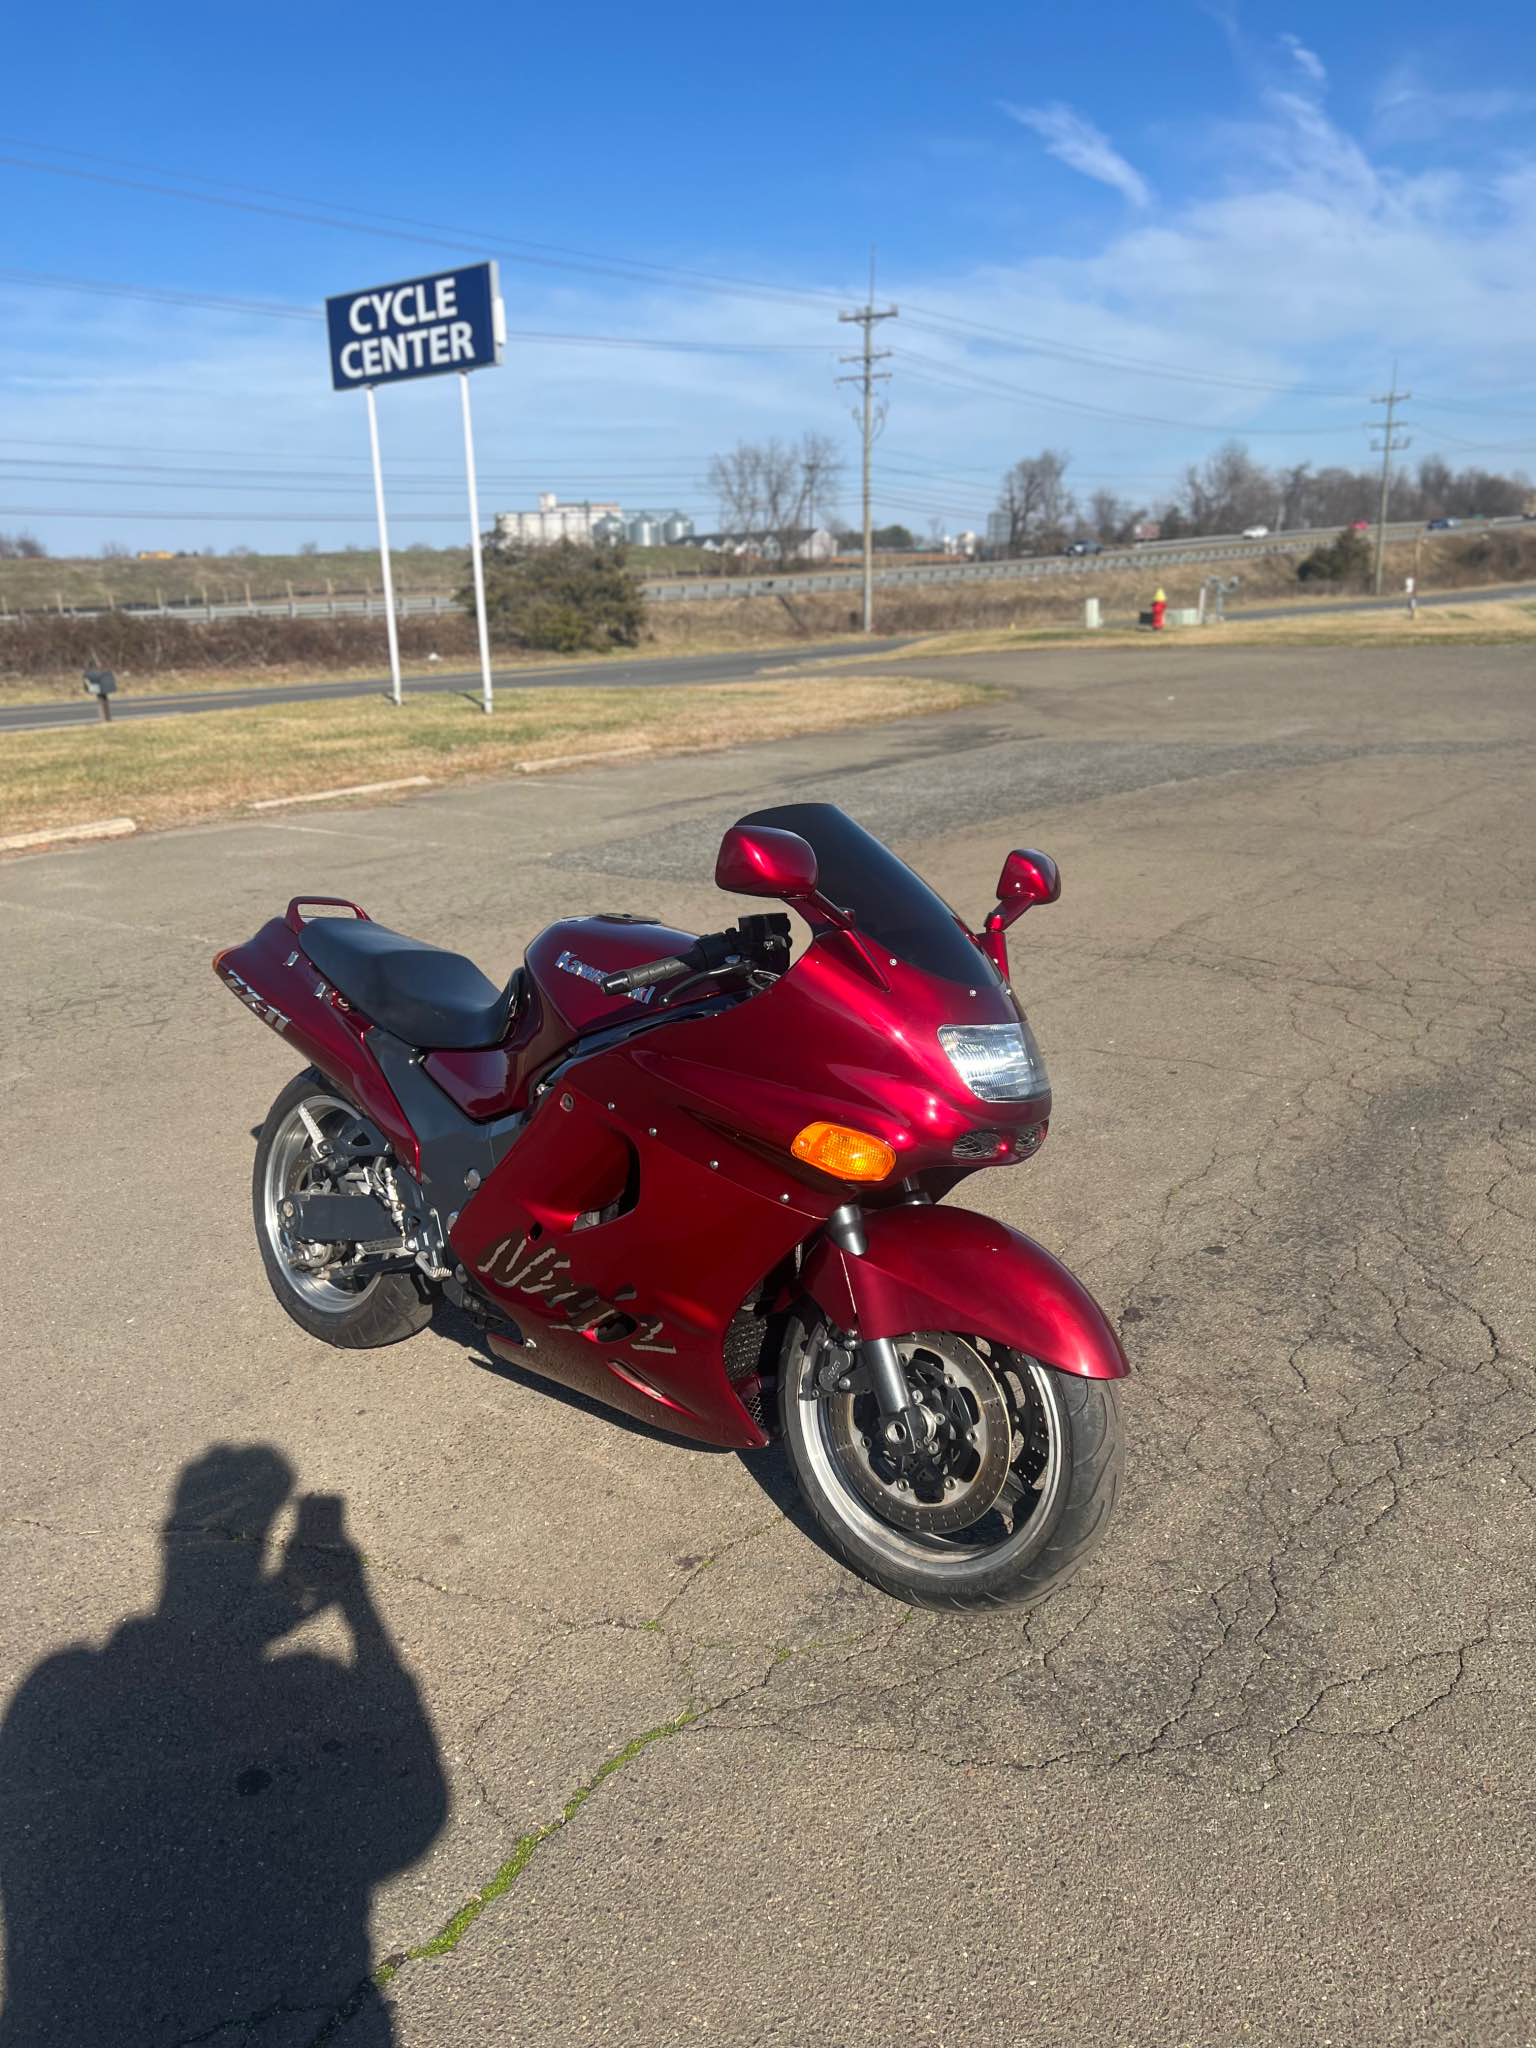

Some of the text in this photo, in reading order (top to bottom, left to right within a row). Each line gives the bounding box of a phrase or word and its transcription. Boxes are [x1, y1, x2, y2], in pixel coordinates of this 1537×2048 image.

[349, 277, 458, 335] CYCLE
[340, 321, 475, 379] CENTER
[555, 950, 656, 1004] Kawaki
